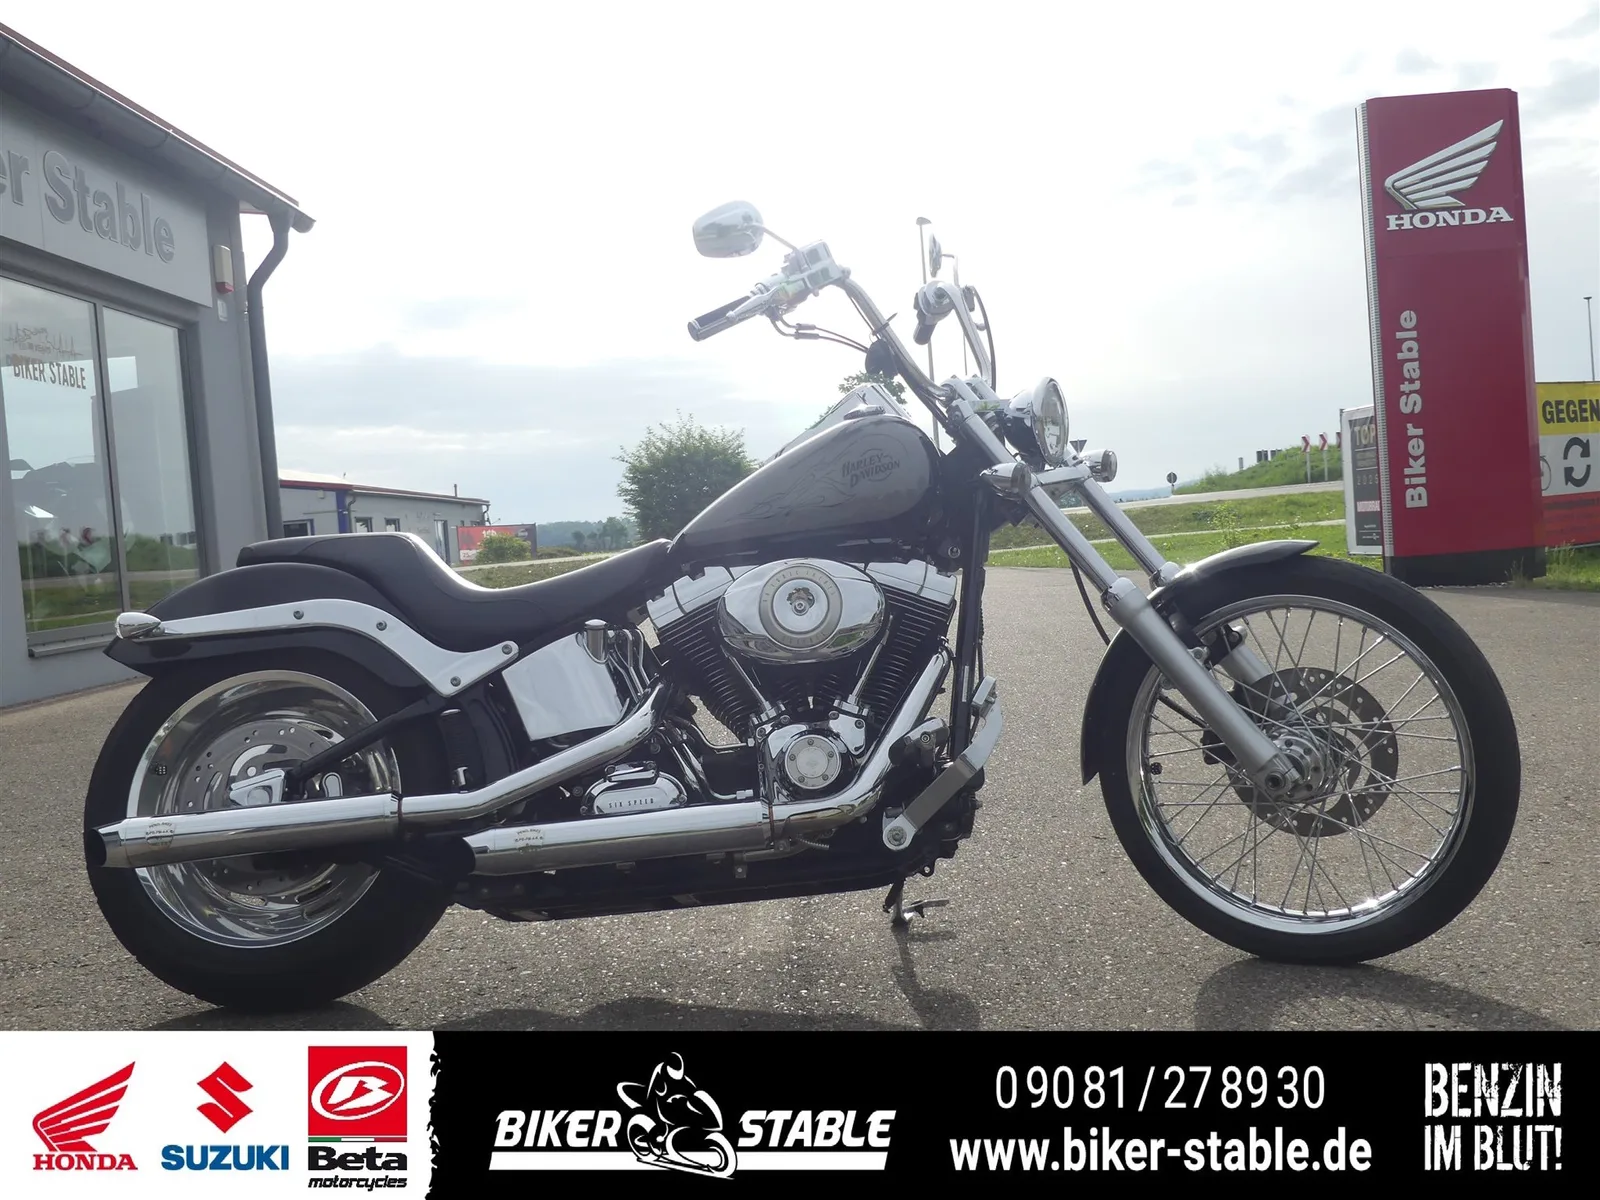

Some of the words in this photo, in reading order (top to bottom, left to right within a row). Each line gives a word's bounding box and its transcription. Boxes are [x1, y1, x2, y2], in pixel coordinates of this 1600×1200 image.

[43, 150, 175, 264] Stable
[1386, 206, 1513, 231] HONDA
[13, 359, 46, 382] BIKER
[49, 361, 87, 389] STABLE
[1396, 310, 1422, 414] Stable
[1541, 399, 1600, 424] GEGEN
[850, 459, 900, 488] DAVIDSON
[1404, 424, 1428, 508] Biker
